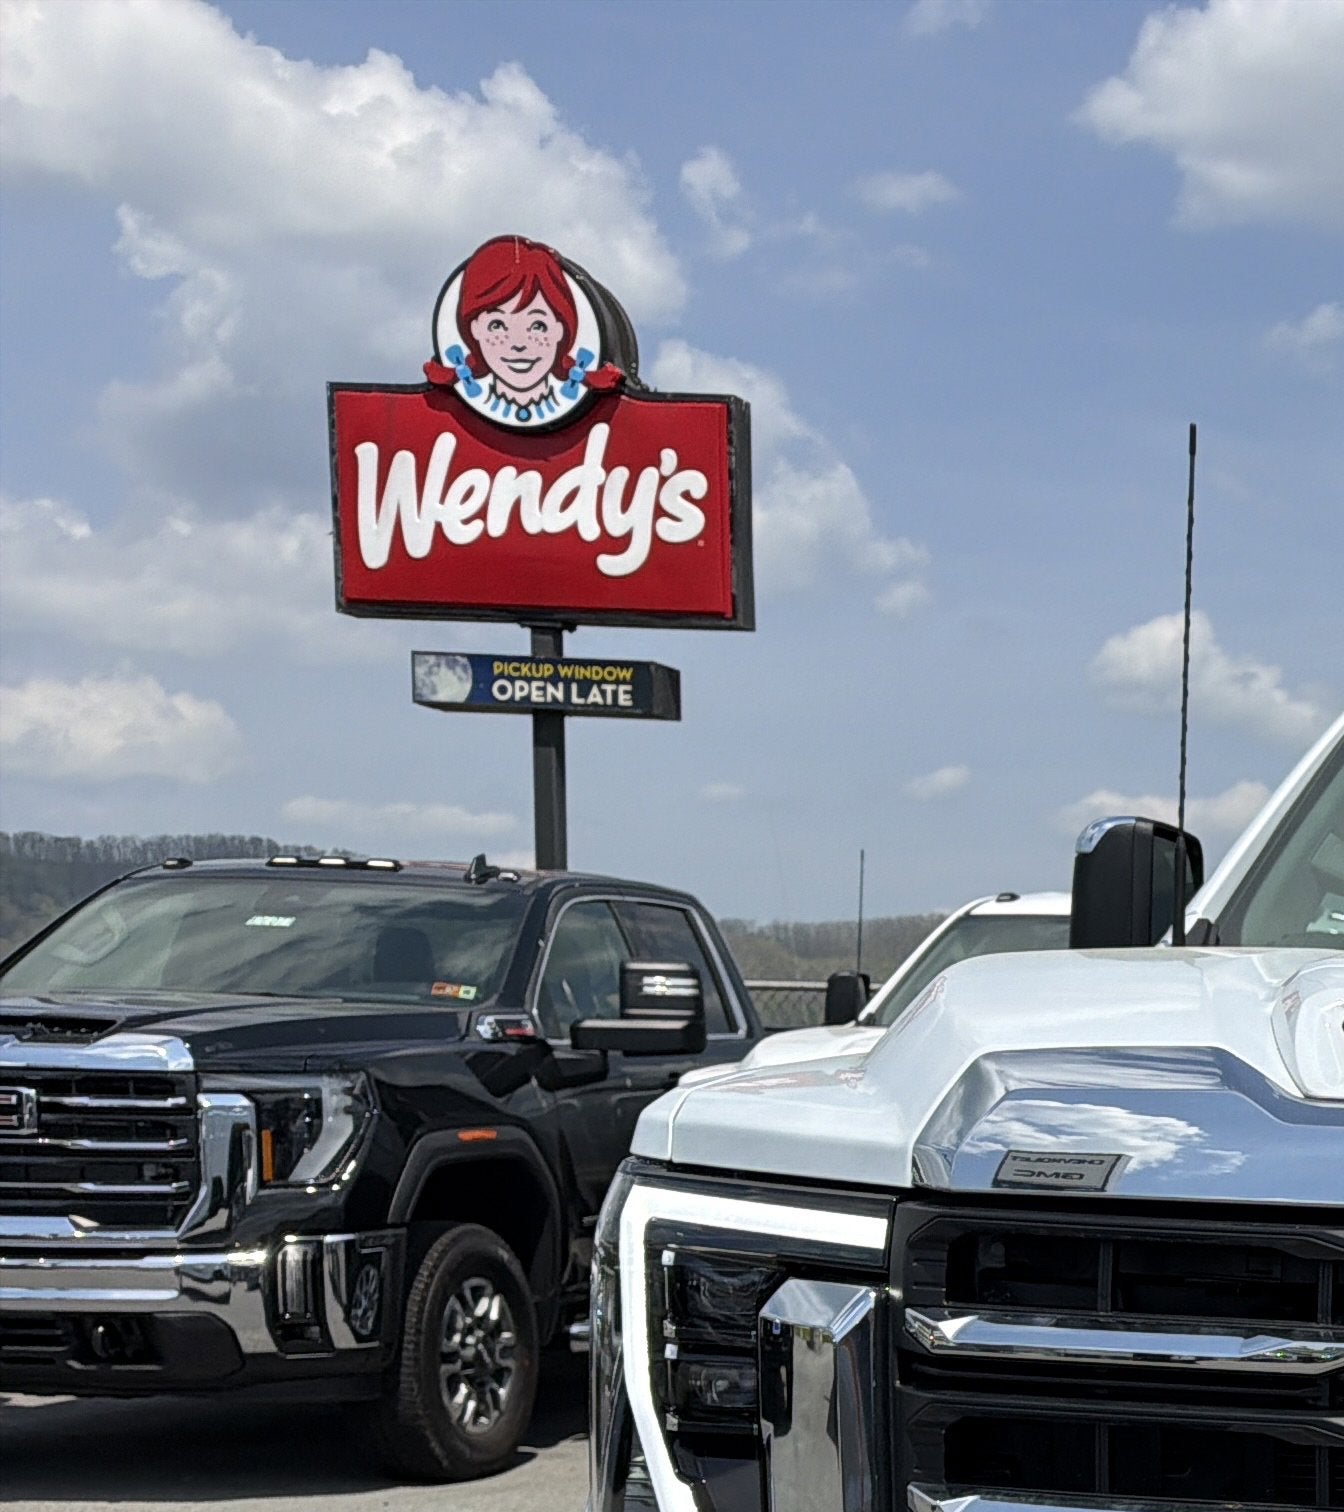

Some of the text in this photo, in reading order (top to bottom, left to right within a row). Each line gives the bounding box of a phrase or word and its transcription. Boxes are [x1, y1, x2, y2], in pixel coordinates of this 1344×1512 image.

[354, 422, 709, 577] Wendy's
[492, 661, 634, 681] PICKUP WINDOW
[491, 679, 634, 707] OPEN LATE
